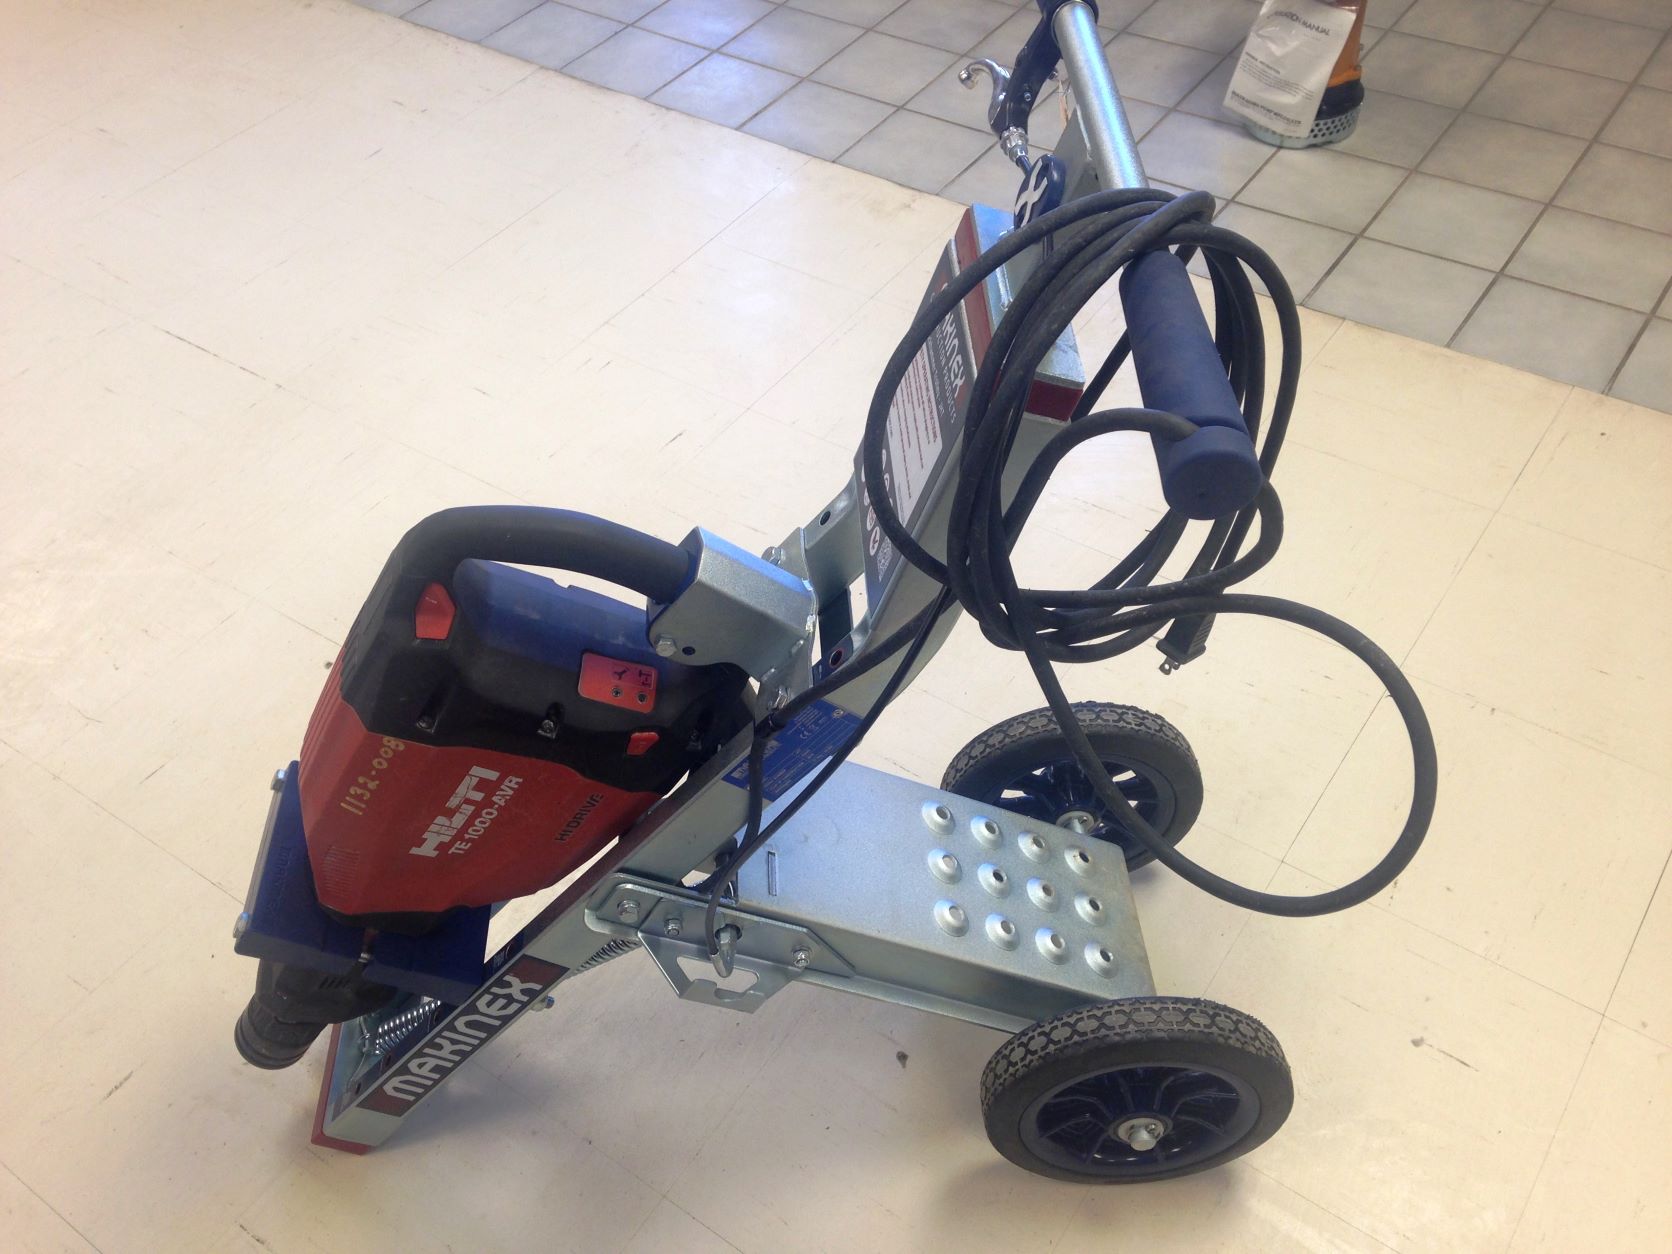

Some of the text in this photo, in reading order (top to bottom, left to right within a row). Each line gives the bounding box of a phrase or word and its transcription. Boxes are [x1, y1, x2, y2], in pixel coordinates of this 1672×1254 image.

[408, 765, 500, 857] HILTI
[448, 775, 523, 854] TE 1000-AVR
[382, 974, 543, 1101] MAKINEX
